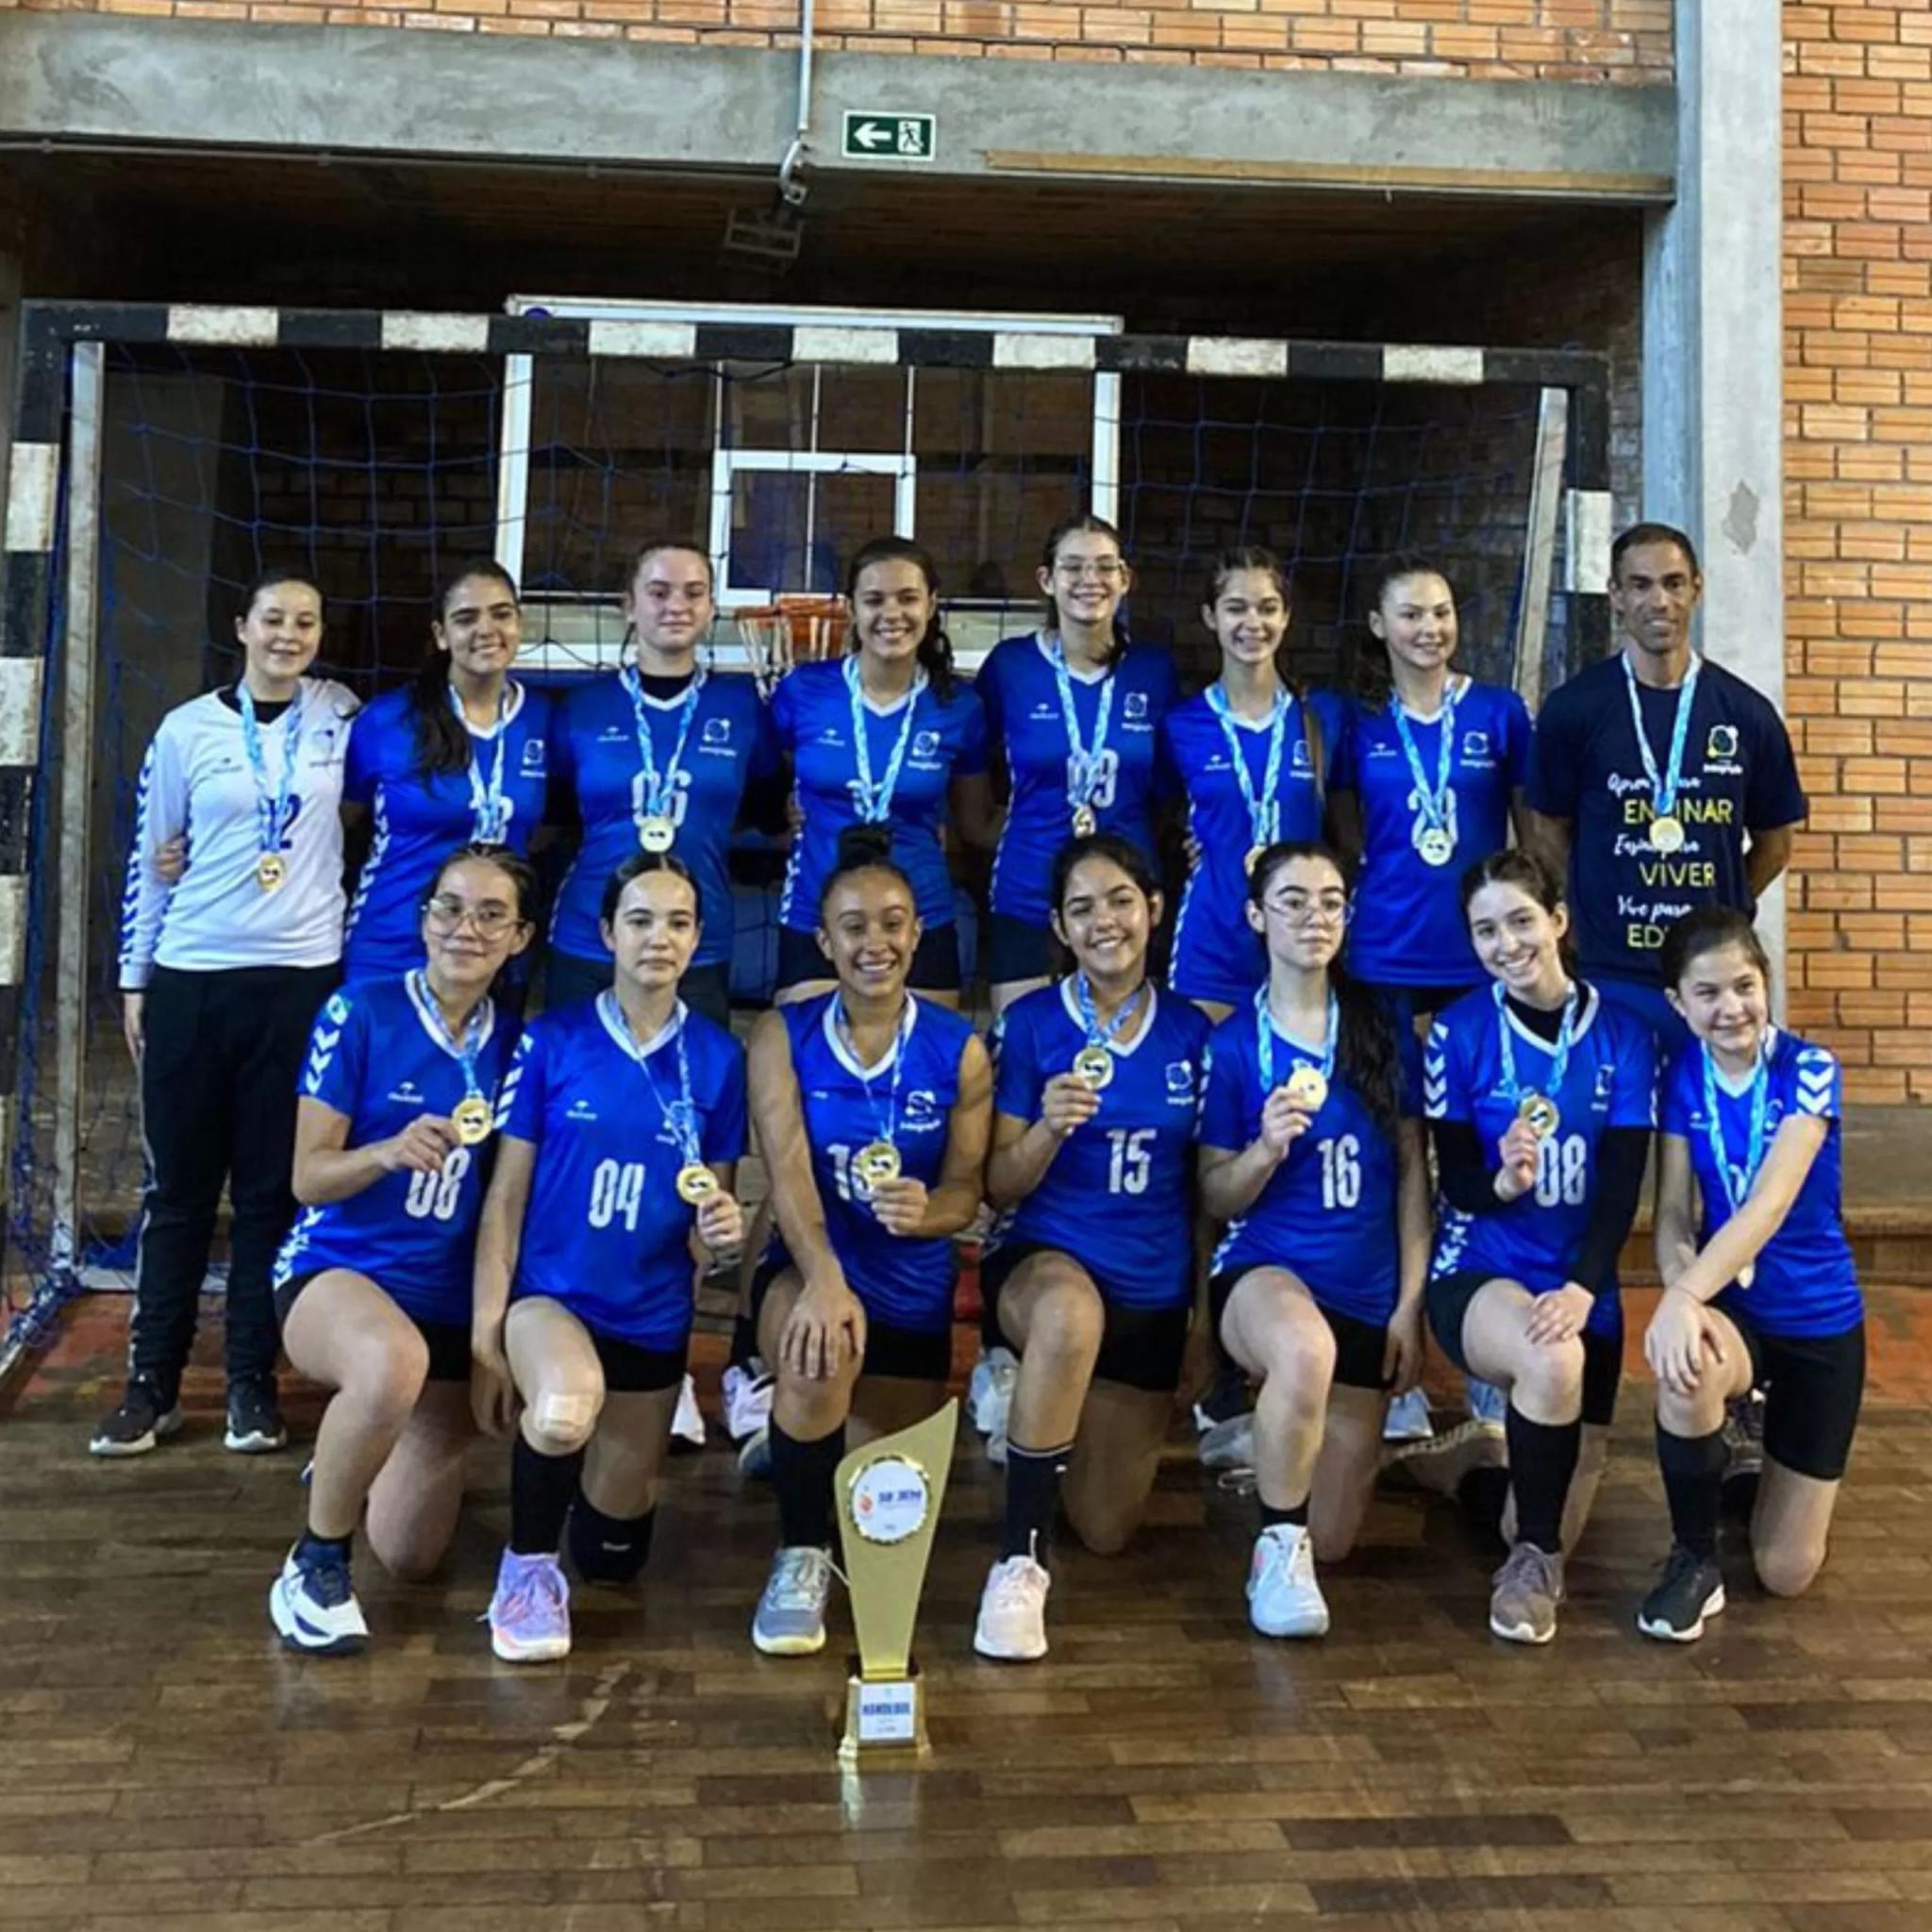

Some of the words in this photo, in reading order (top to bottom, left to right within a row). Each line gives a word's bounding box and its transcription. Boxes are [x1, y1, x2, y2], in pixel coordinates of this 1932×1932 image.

[1624, 798, 1733, 824] ENINAR
[1638, 861, 1715, 887] VIVER
[405, 1146, 471, 1221] 08
[588, 1157, 646, 1232] 04
[1107, 1127, 1158, 1194] 15
[1317, 1133, 1361, 1208] 16
[1535, 1134, 1587, 1208] 08
